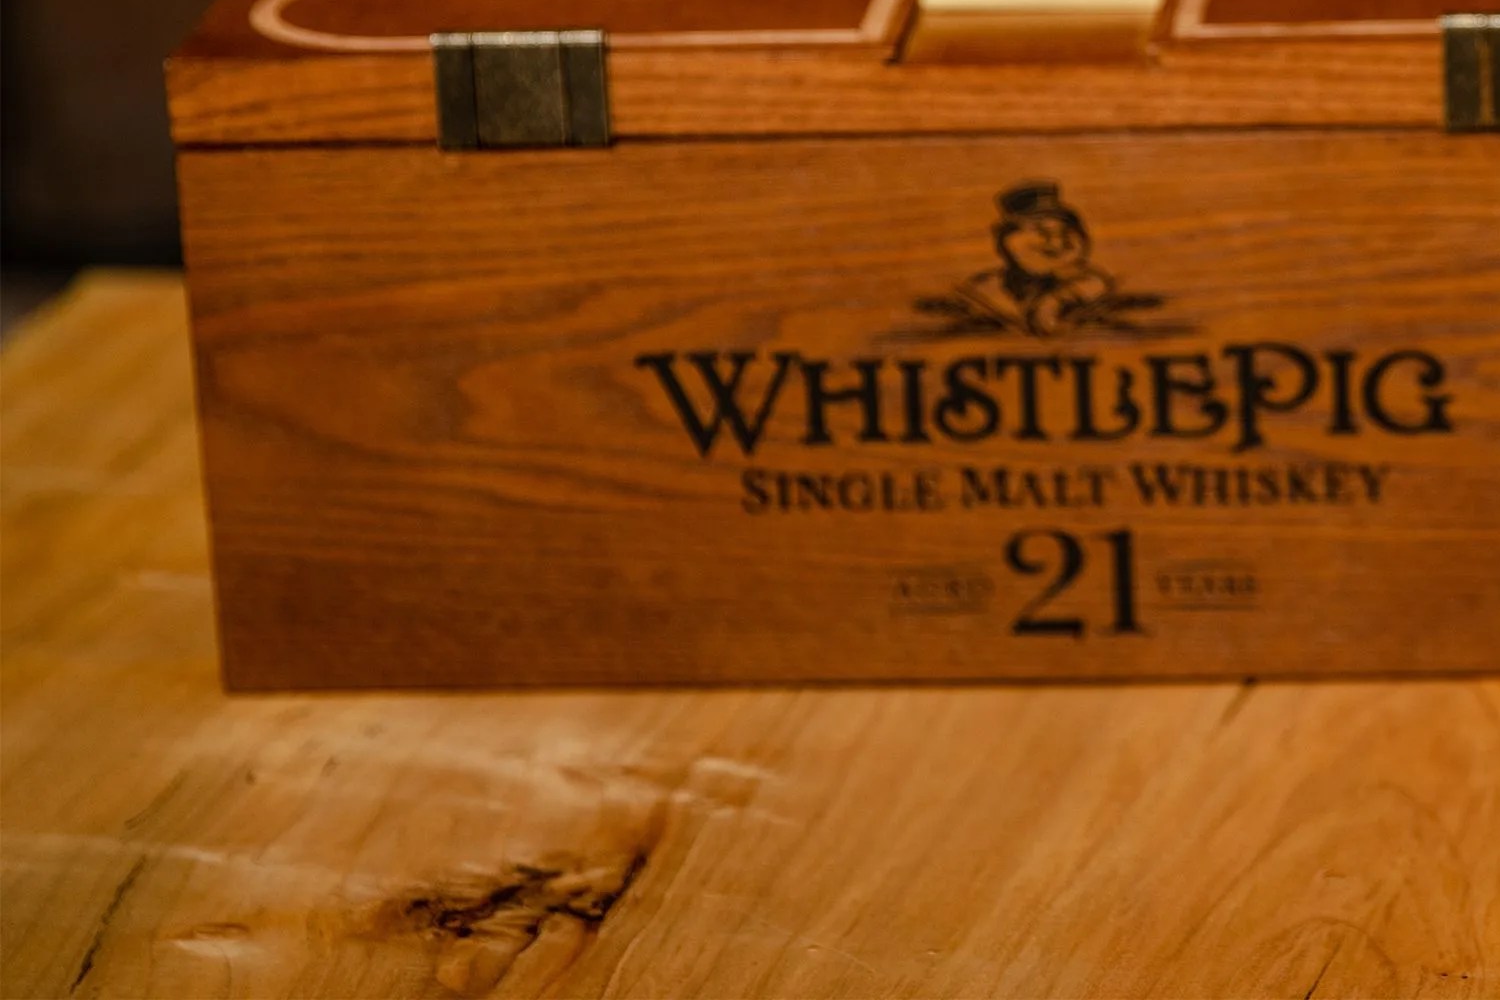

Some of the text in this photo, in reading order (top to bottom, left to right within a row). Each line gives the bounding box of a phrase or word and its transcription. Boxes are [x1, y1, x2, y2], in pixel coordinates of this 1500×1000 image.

[634, 341, 1459, 459] WHISTLEPIG
[739, 461, 1393, 515] SINGLE MALT WHISKEY
[1003, 526, 1149, 642] 21
